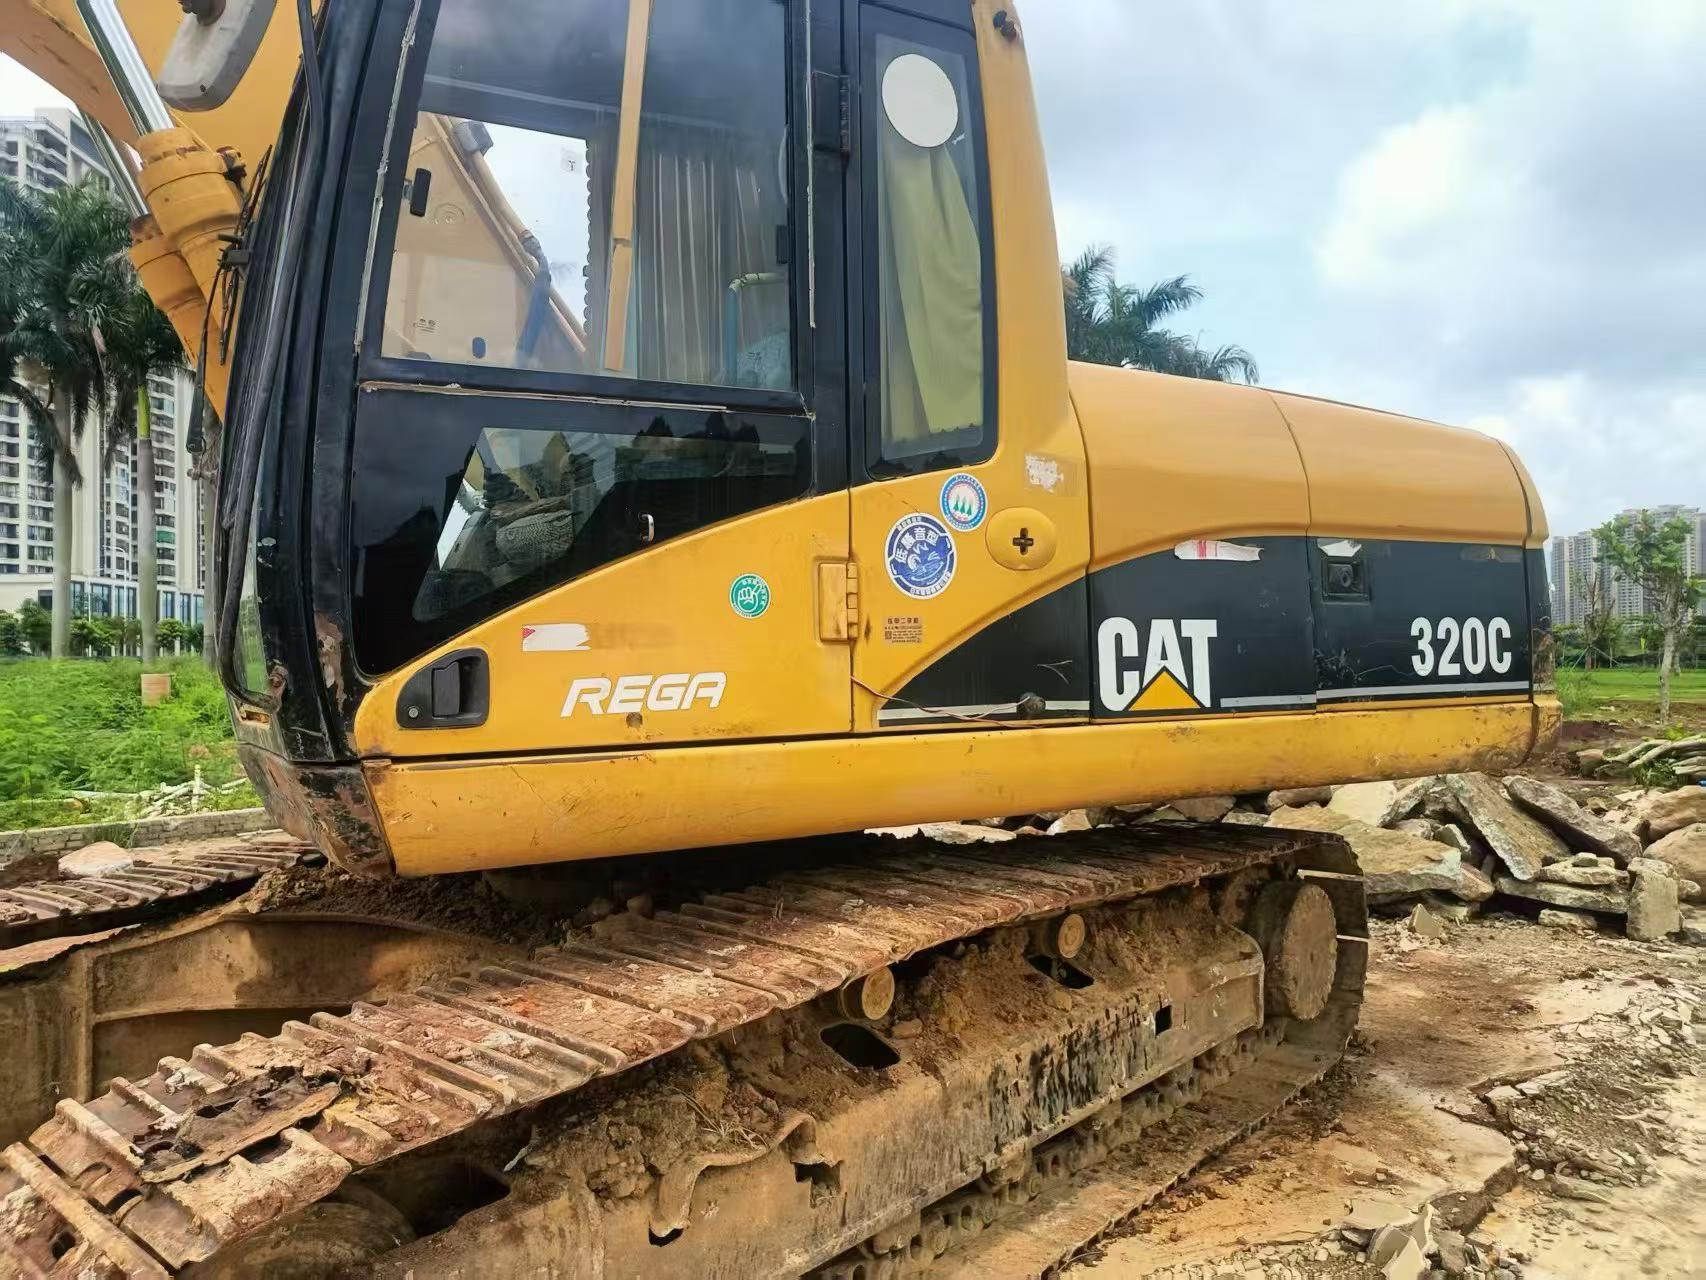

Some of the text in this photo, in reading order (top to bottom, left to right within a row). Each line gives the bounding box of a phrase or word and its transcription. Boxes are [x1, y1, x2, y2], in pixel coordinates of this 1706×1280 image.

[1097, 616, 1218, 712] CAT
[1410, 616, 1512, 677] 320C
[560, 671, 727, 718] REGA
